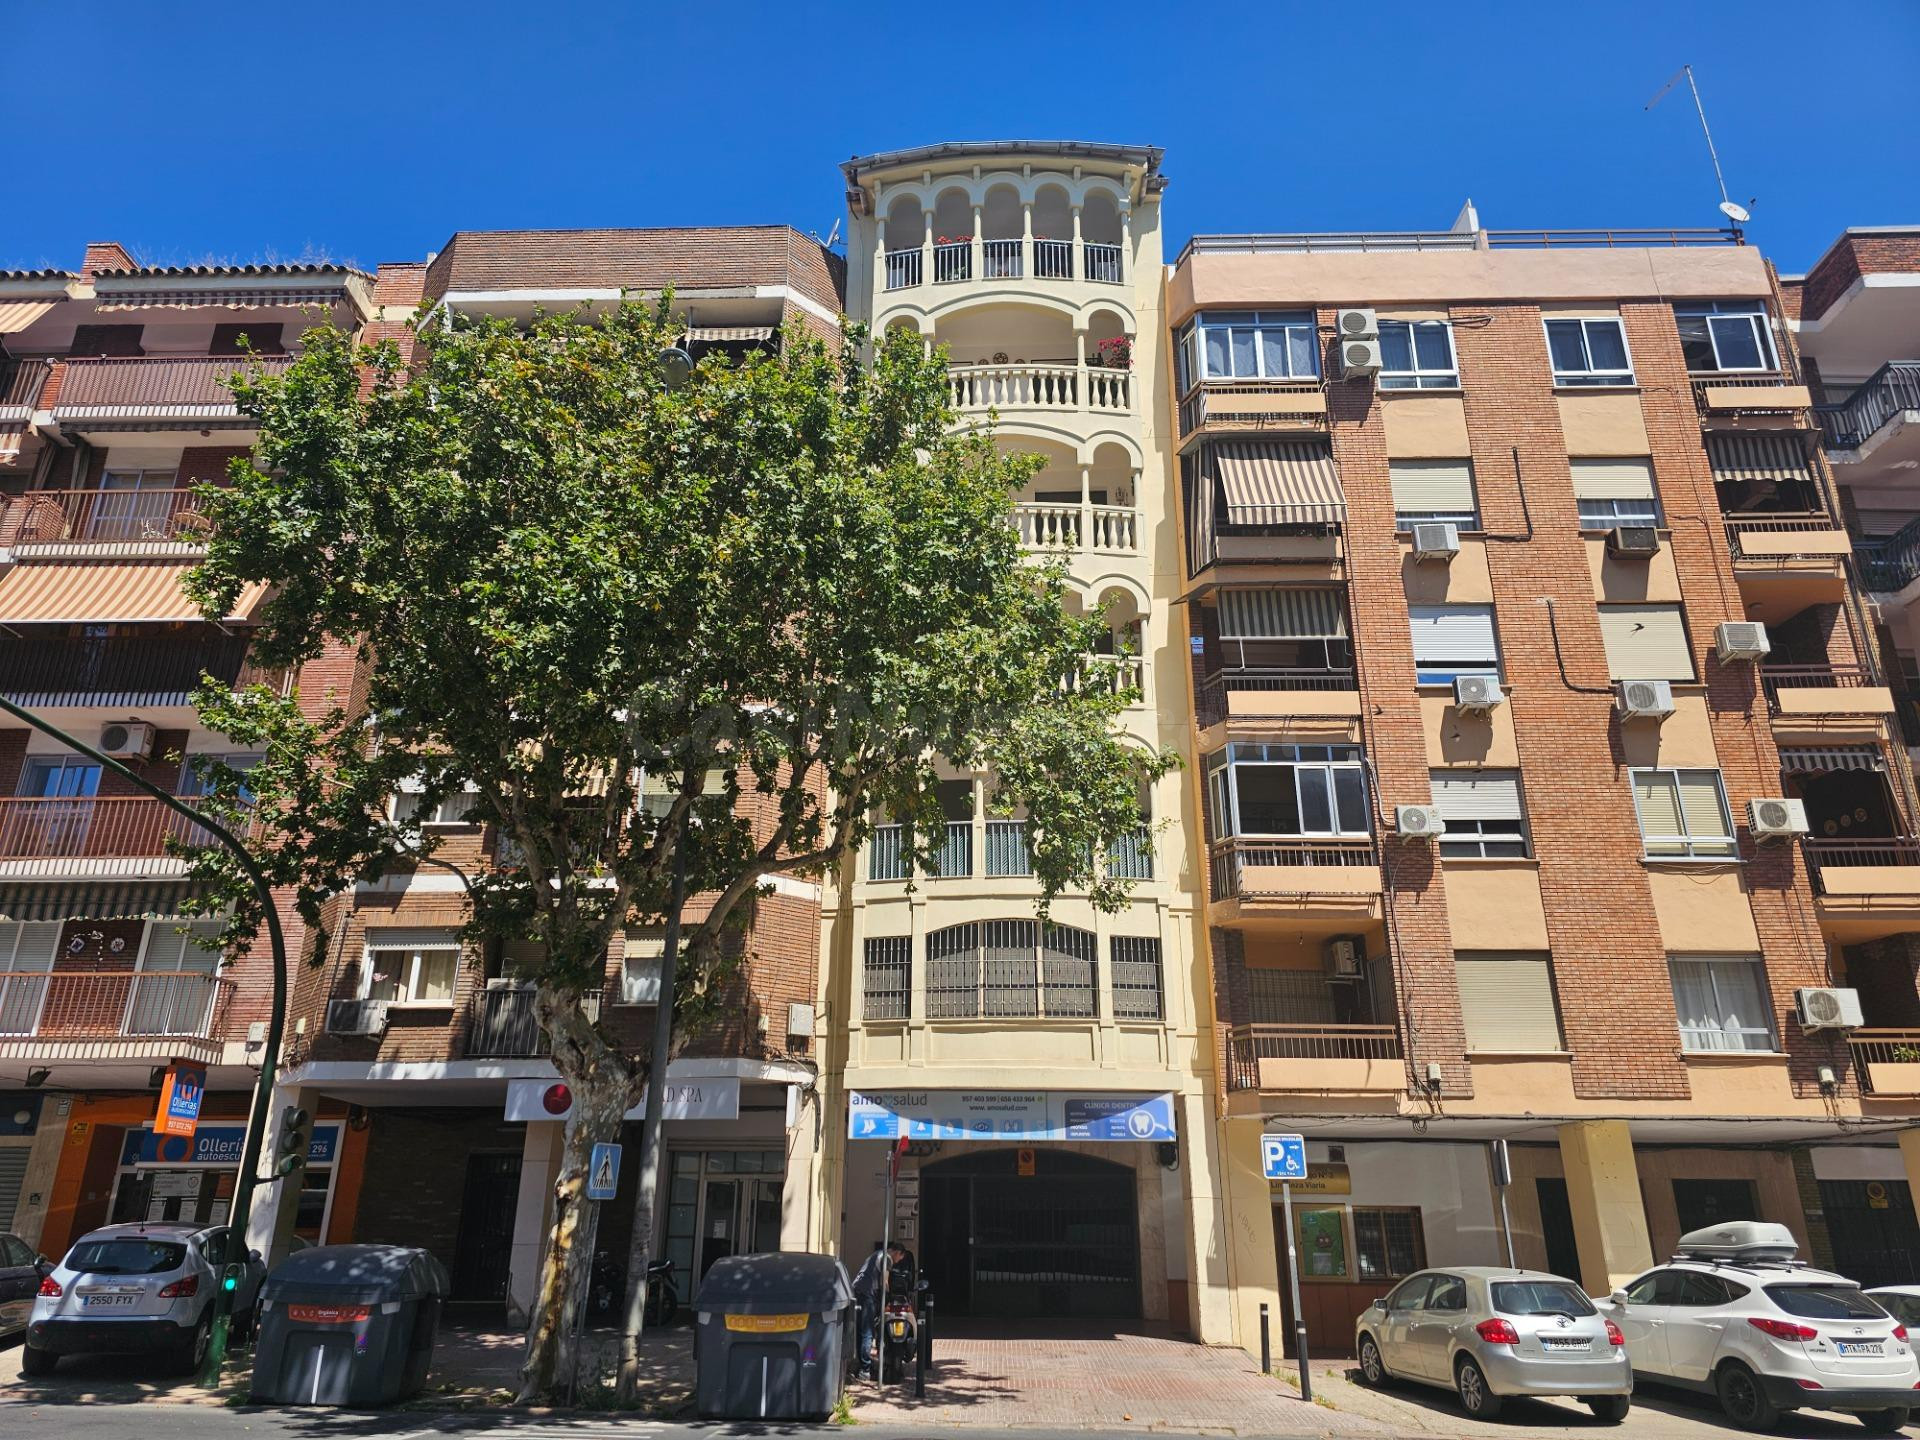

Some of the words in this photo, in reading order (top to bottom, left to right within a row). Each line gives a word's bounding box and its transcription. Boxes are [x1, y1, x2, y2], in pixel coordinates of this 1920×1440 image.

[680, 1086, 702, 1103] SPA
[893, 1092, 928, 1106] salud
[199, 1137, 245, 1152] Ollería
[197, 1152, 241, 1161] autoescu
[1264, 1141, 1285, 1171] P
[90, 1295, 113, 1305] 2550
[115, 1295, 134, 1305] FYX
